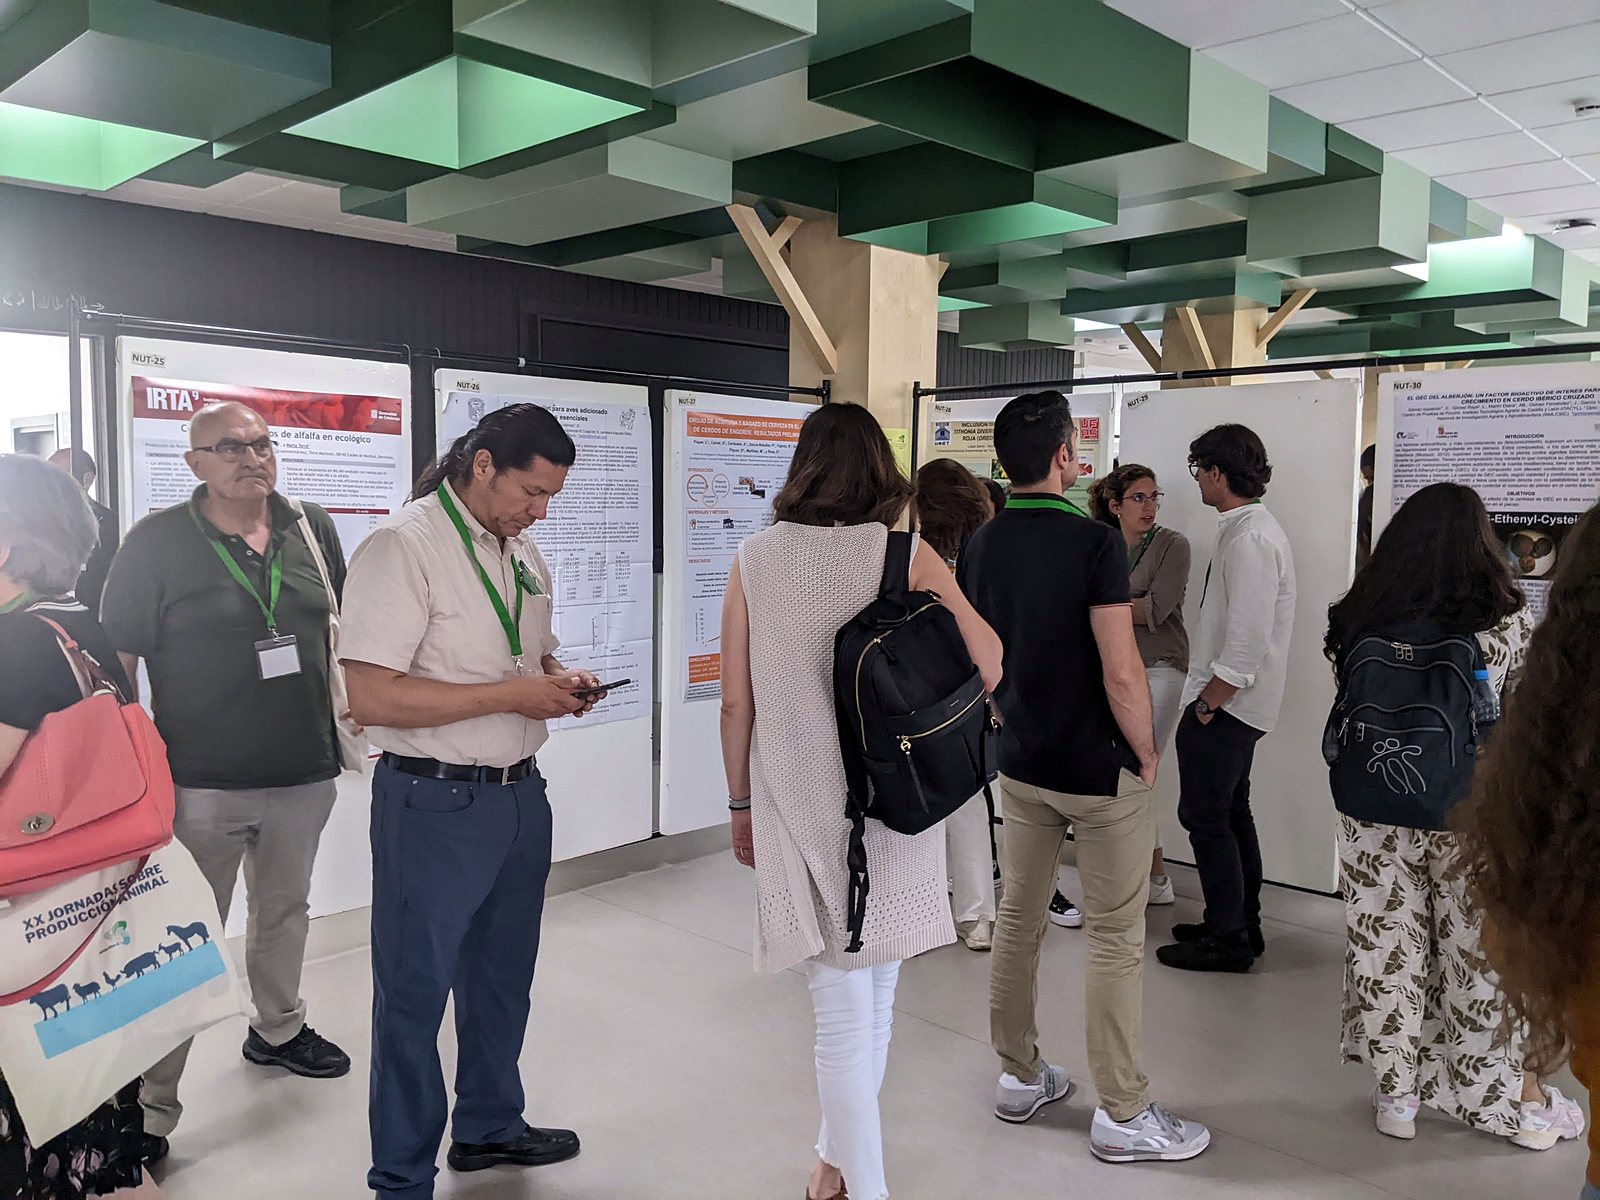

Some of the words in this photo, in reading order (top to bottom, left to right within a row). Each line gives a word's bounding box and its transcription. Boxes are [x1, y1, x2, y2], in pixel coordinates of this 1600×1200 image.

[132, 353, 165, 366] NUT-25
[456, 382, 480, 390] NUT-26
[1393, 382, 1421, 390] NUT-30
[1127, 395, 1148, 408] NUT-29
[580, 407, 608, 415] adicionado
[281, 430, 291, 438] de
[294, 431, 320, 440] alfalfa
[335, 434, 371, 444] ecológico
[23, 913, 45, 930] XX
[48, 883, 118, 922] JORNADAS
[119, 863, 163, 889] SOBRE
[119, 875, 169, 905] ANIMAL
